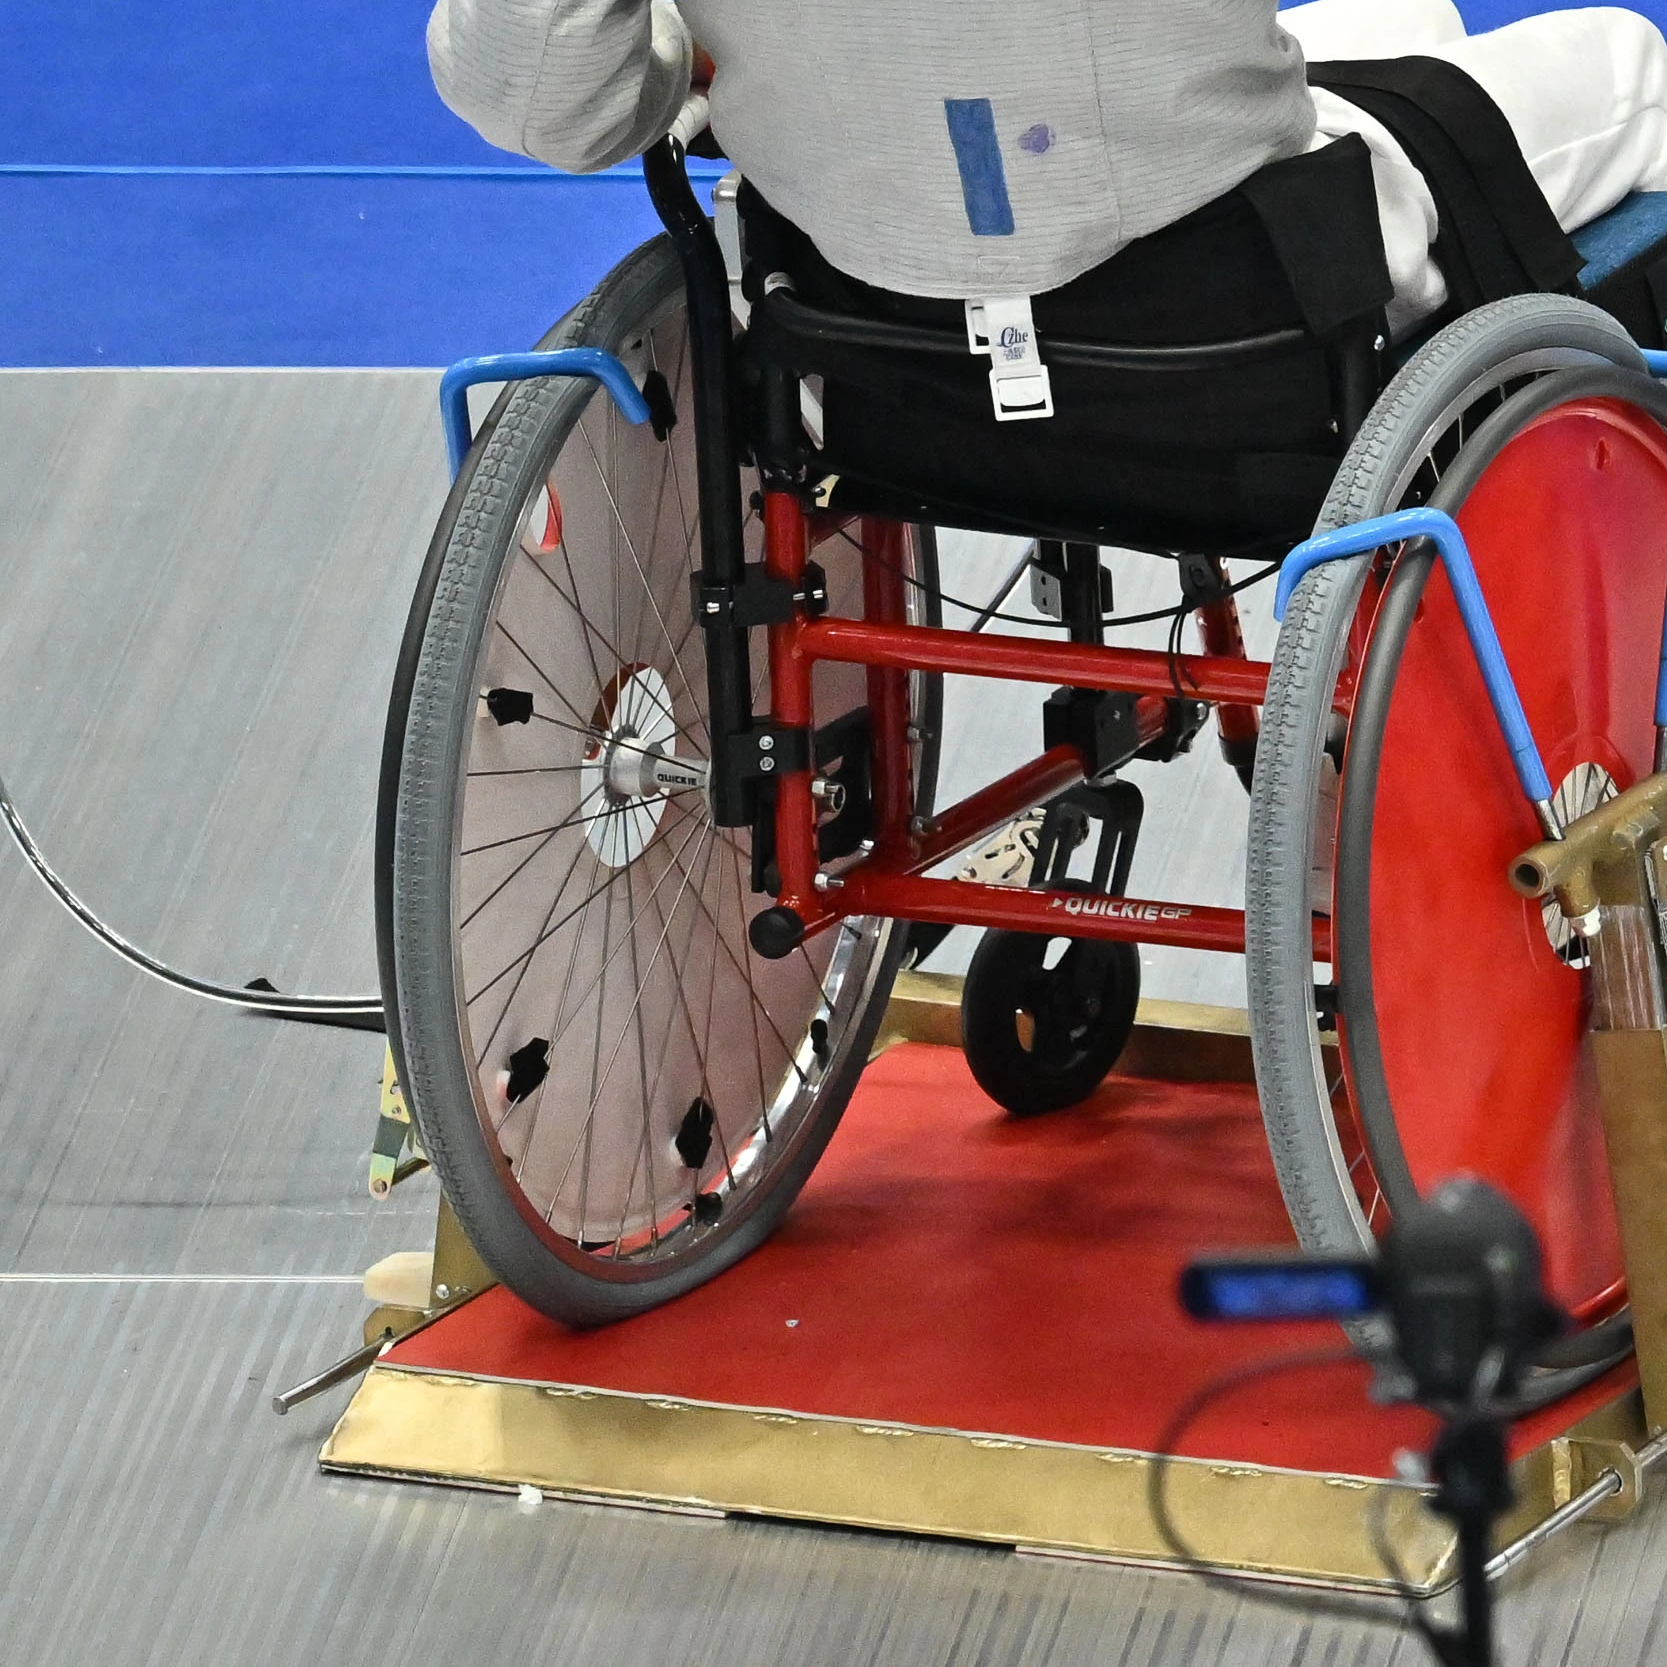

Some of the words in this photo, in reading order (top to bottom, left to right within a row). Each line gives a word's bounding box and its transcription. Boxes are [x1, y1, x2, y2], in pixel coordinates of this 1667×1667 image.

[657, 773, 698, 786] QUICKIE
[1065, 897, 1161, 922] QUICKIE
[1160, 907, 1193, 920] GP
